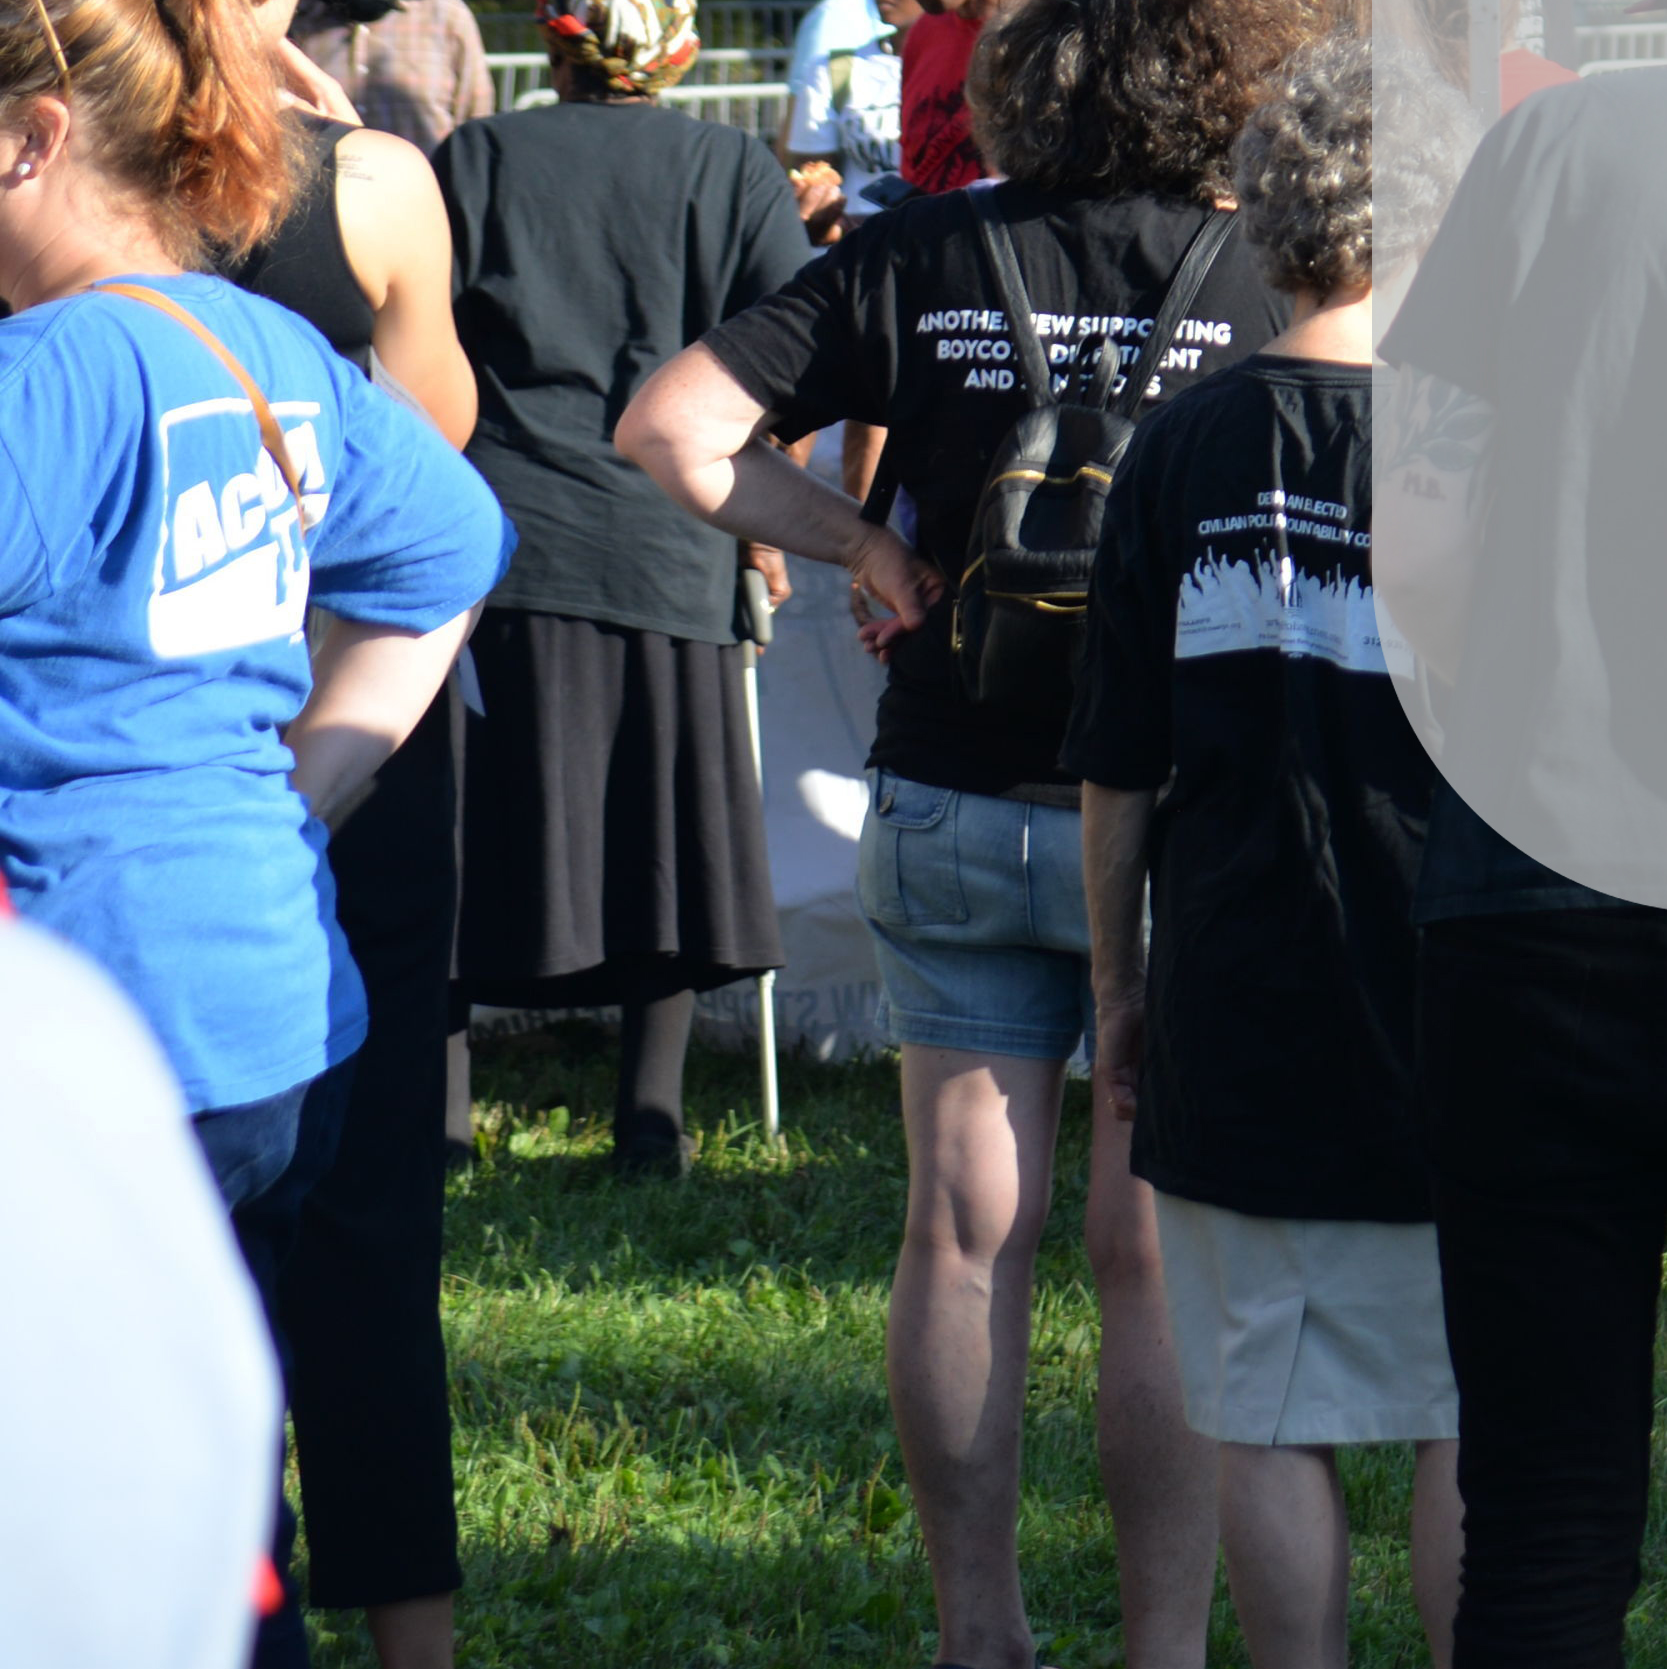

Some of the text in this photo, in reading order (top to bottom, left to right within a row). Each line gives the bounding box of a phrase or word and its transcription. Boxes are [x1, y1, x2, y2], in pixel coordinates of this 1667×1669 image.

[1078, 316, 1232, 345] SUPPOTING
[936, 339, 1018, 360] BOYCO
[964, 368, 1014, 390] AND
